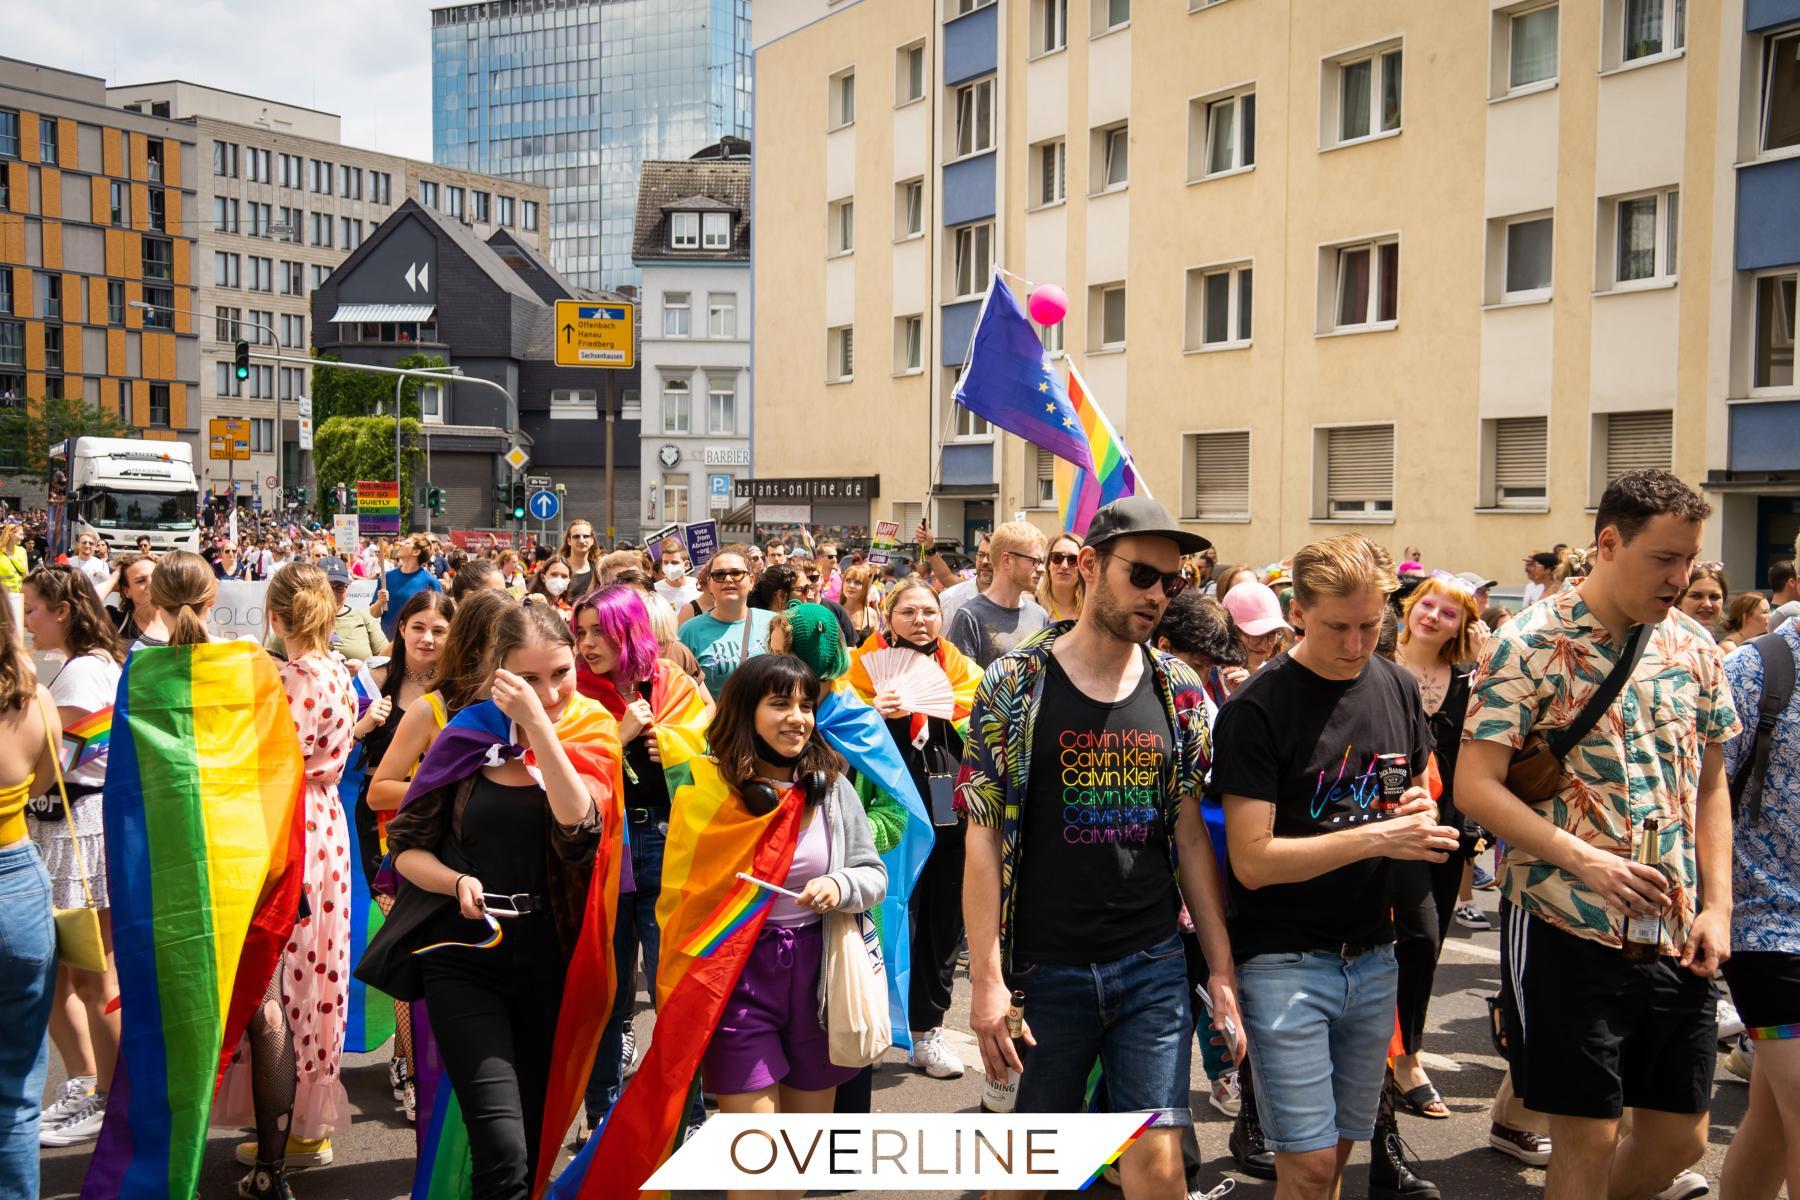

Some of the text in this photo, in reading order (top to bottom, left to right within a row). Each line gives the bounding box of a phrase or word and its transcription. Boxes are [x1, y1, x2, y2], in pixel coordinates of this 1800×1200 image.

[578, 340, 614, 350] Friedberg
[580, 352, 623, 360] Sachsenhausen
[706, 450, 749, 464] BARBIER
[737, 482, 862, 496] balans-online.de
[691, 540, 713, 549] Abroad
[696, 534, 710, 542] from
[1060, 728, 1164, 749] Calvin Klein
[1060, 748, 1164, 768] Calvin Klein
[1062, 767, 1121, 786] Calvin
[1062, 786, 1160, 806] Calvin Klein
[1063, 804, 1158, 824] Calvin Klein
[1064, 824, 1122, 844] Calvin
